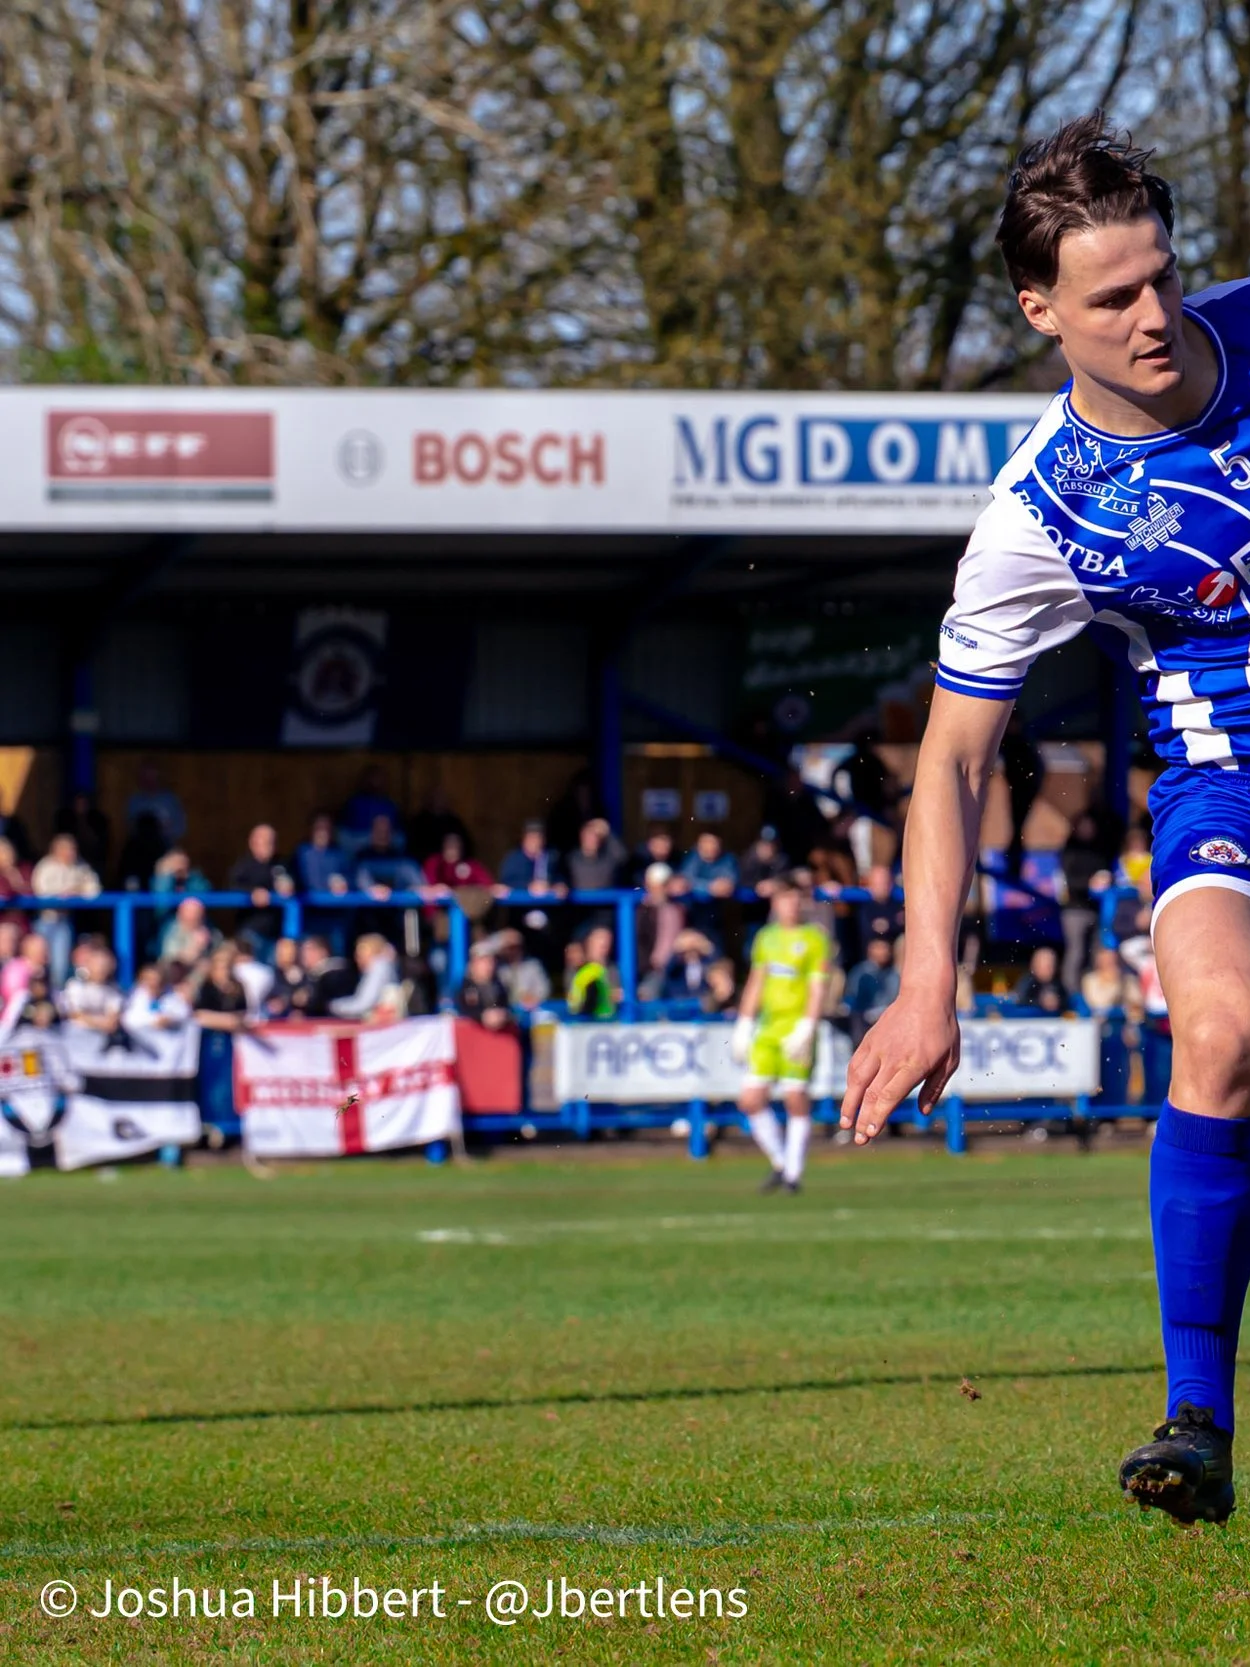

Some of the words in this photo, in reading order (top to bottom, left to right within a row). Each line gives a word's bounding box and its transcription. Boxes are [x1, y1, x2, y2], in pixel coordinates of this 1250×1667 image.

[62, 422, 208, 466] NEFF
[413, 431, 605, 486] BOSCH
[1062, 481, 1108, 497] ABSQUE
[1112, 501, 1138, 514] LAB
[1126, 504, 1184, 549] MATCHWINNER
[585, 1032, 710, 1078] APEX
